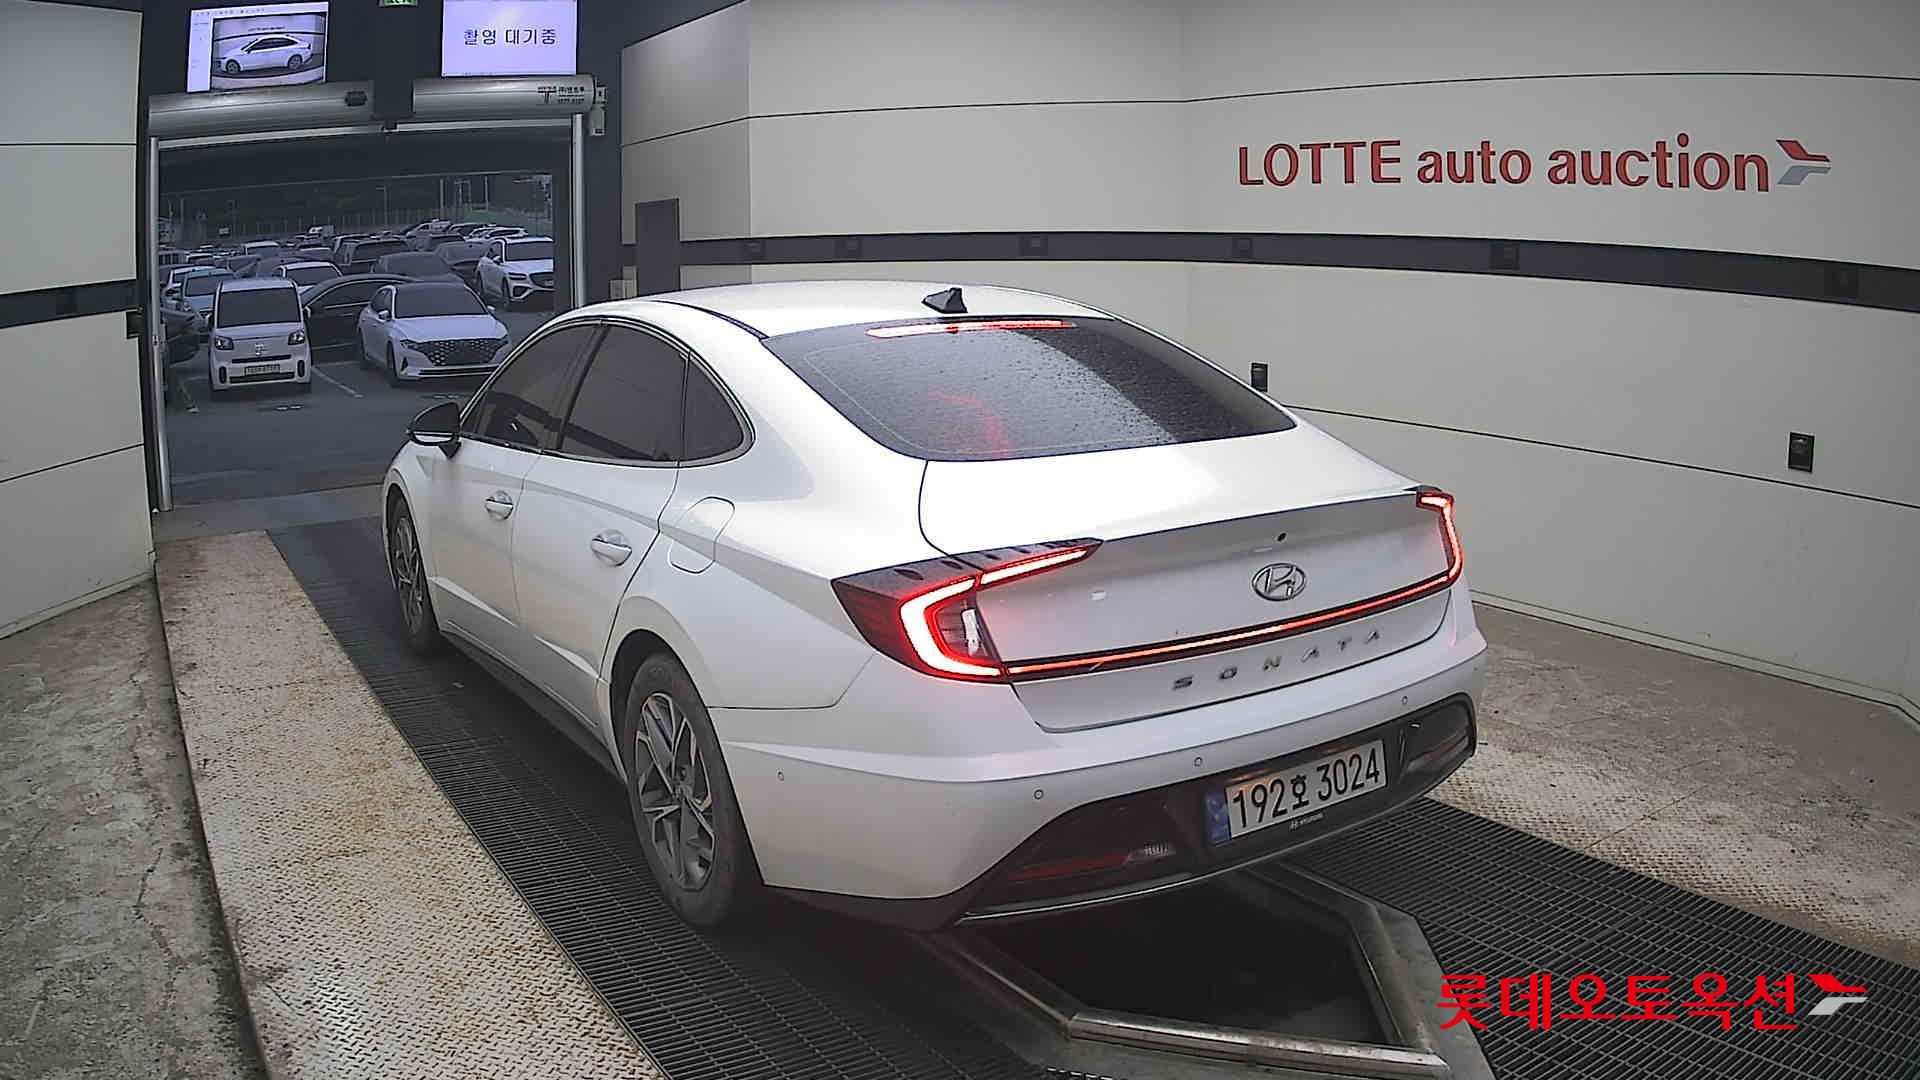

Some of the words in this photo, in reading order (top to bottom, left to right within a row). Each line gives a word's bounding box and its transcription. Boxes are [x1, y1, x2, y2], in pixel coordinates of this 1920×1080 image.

[505, 29, 556, 45] 대기중
[1238, 140, 1401, 186] LOTTE
[1416, 140, 1533, 185] auto
[1547, 132, 1770, 193] auction
[1172, 629, 1380, 690] SONATA
[1232, 774, 1310, 828] 192호
[1316, 748, 1381, 801] 3024
